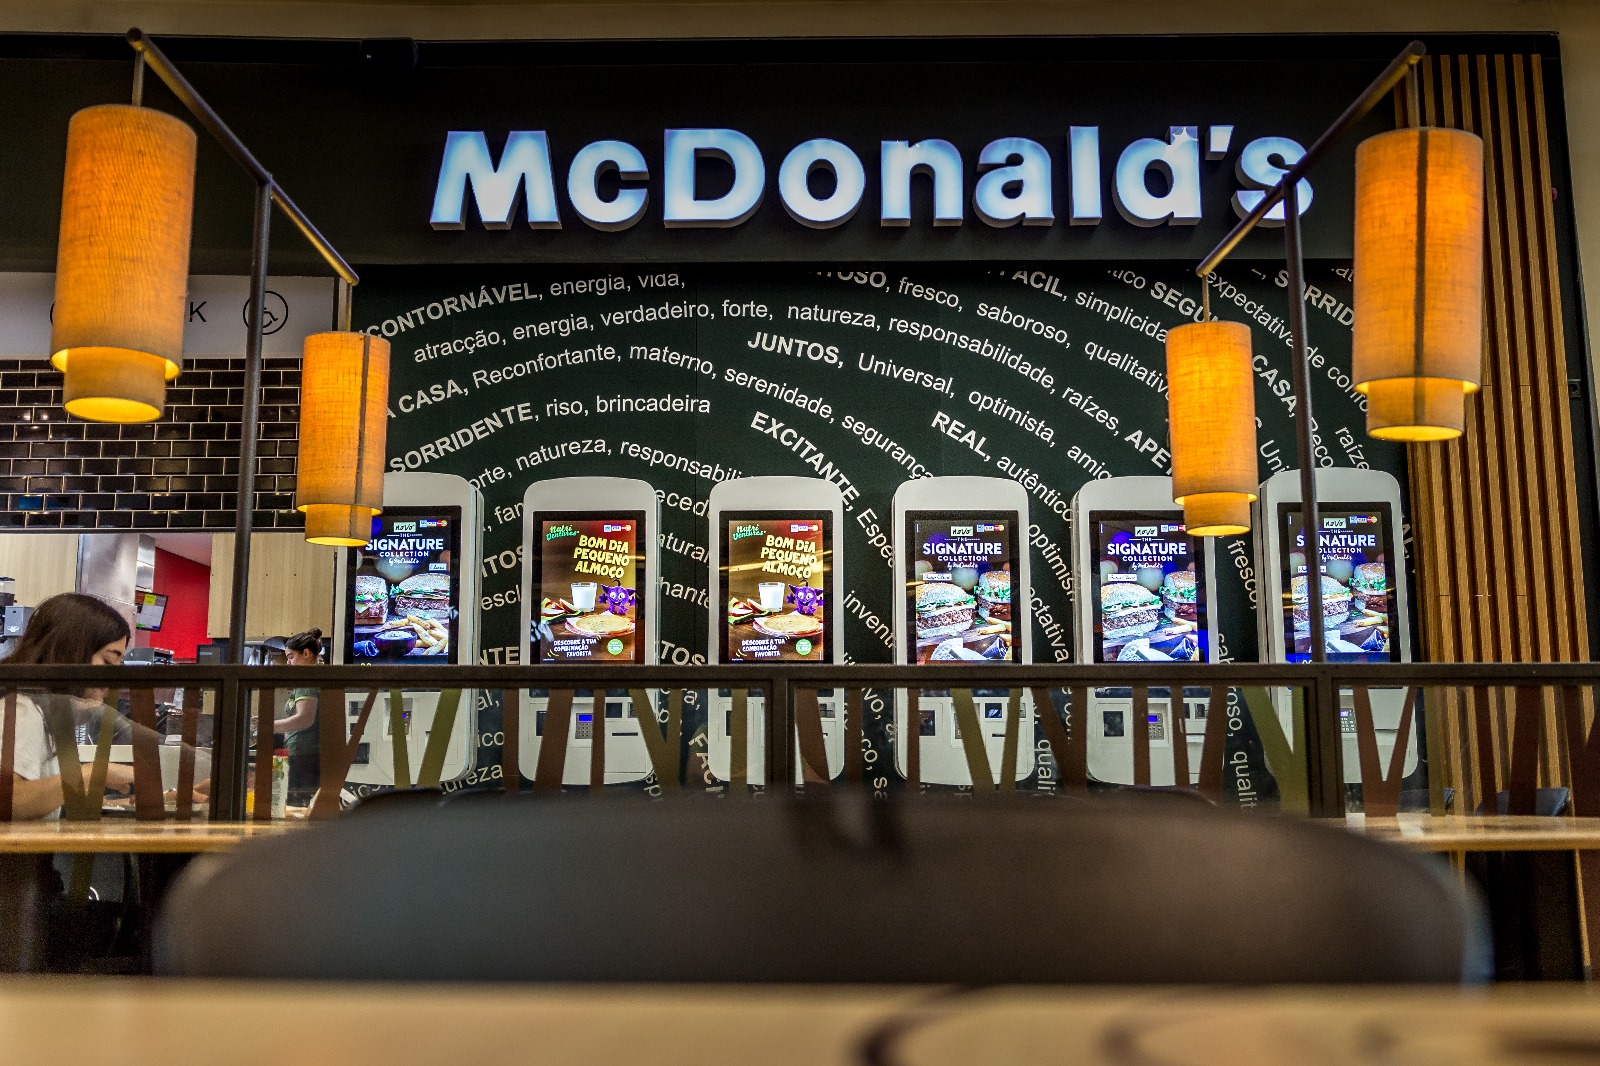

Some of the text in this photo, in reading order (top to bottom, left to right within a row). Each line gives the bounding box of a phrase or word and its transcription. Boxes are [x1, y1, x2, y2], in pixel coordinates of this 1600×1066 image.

[429, 125, 1314, 232] McDonald's
[358, 282, 543, 338] CONTORNÁVEL,
[550, 273, 631, 296] energia,
[898, 276, 963, 312] fresco,
[976, 302, 1071, 348] saboroso,
[1150, 281, 1219, 323] SEGU
[398, 379, 469, 413] CASA,
[472, 344, 621, 389] Reconfortante,
[629, 343, 717, 379] materno,
[724, 366, 835, 423] serenidade,
[414, 300, 1172, 476] atracção, energia, verdadeiro, forte, natureza, responsabilidade, raízes, APE
[747, 331, 844, 369] JUNTOS,
[858, 353, 955, 398] Universal,
[968, 389, 1056, 448] optimista,
[932, 411, 991, 461] REAL,
[389, 402, 539, 473] SORRIDENTE,
[545, 398, 589, 417] riso,
[596, 394, 711, 413] brincadeira
[750, 411, 860, 512] EXCITANTE,
[515, 439, 612, 471] natureza,
[365, 538, 444, 551] SIGNATURE
[579, 534, 607, 550] BOM
[765, 534, 794, 550] BOM
[922, 542, 1002, 555] SIGNATURE
[1107, 542, 1187, 555] SIGNATURE
[1296, 534, 1376, 547] SNATURE
[573, 547, 630, 567] PEQUENO
[574, 560, 625, 579] ALMOÇO
[760, 547, 817, 567] PEQUENO
[761, 560, 812, 579] ALMOÇO
